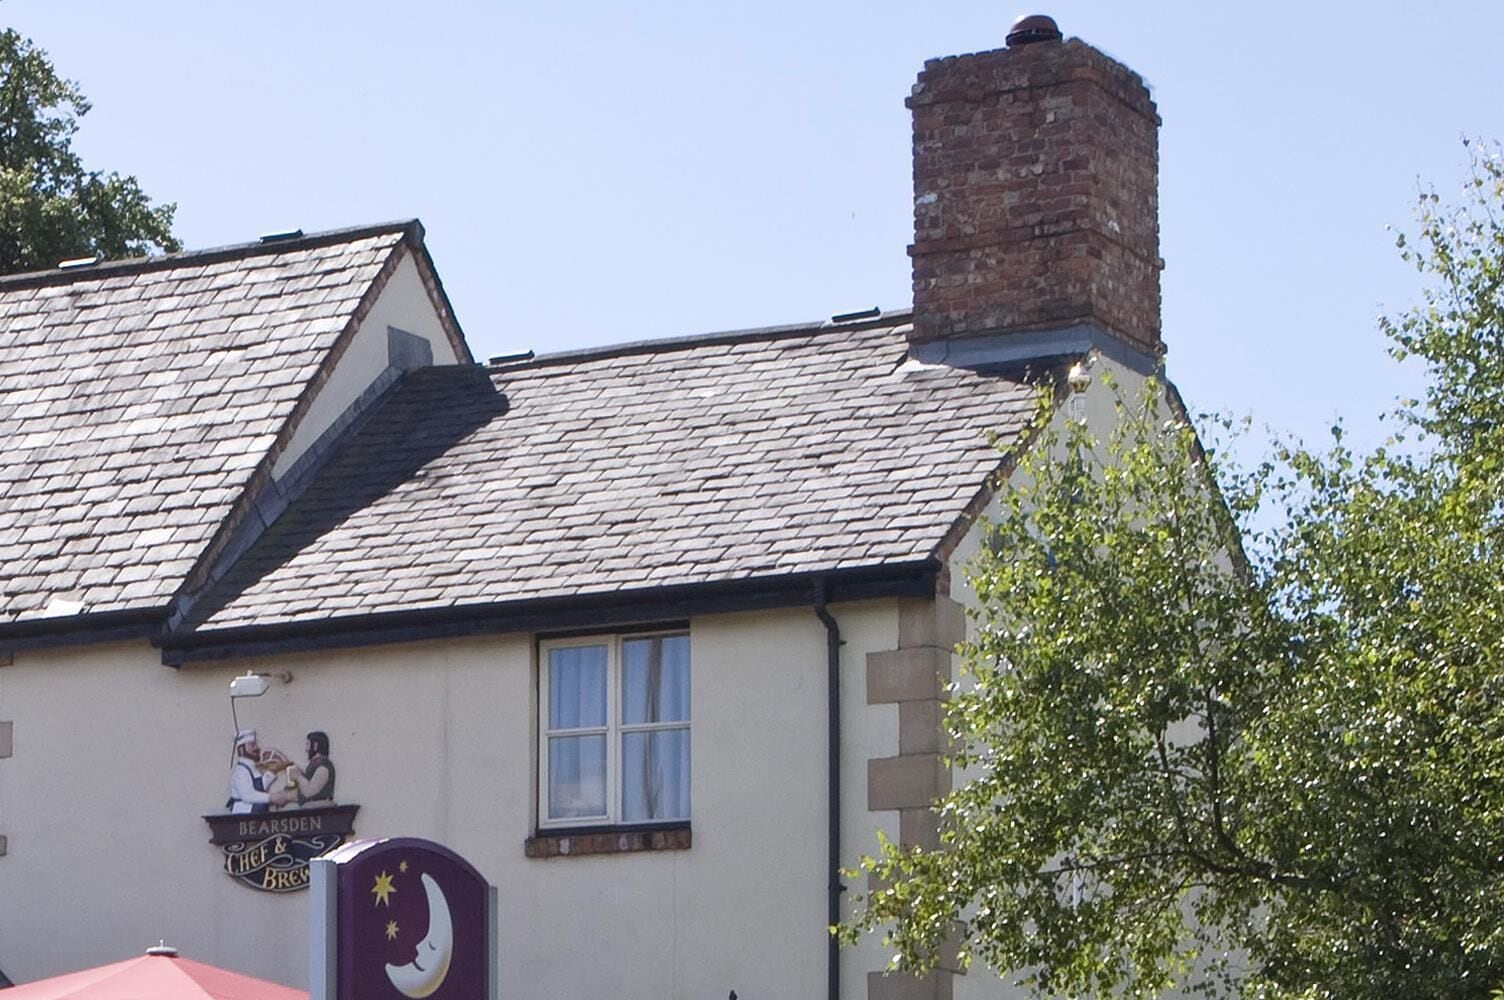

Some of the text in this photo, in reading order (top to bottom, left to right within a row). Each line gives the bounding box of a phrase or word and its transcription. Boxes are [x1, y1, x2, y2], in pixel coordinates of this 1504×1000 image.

[239, 816, 322, 836] BEARSDEN
[226, 836, 287, 875] CHEF &
[262, 866, 310, 889] BREW
